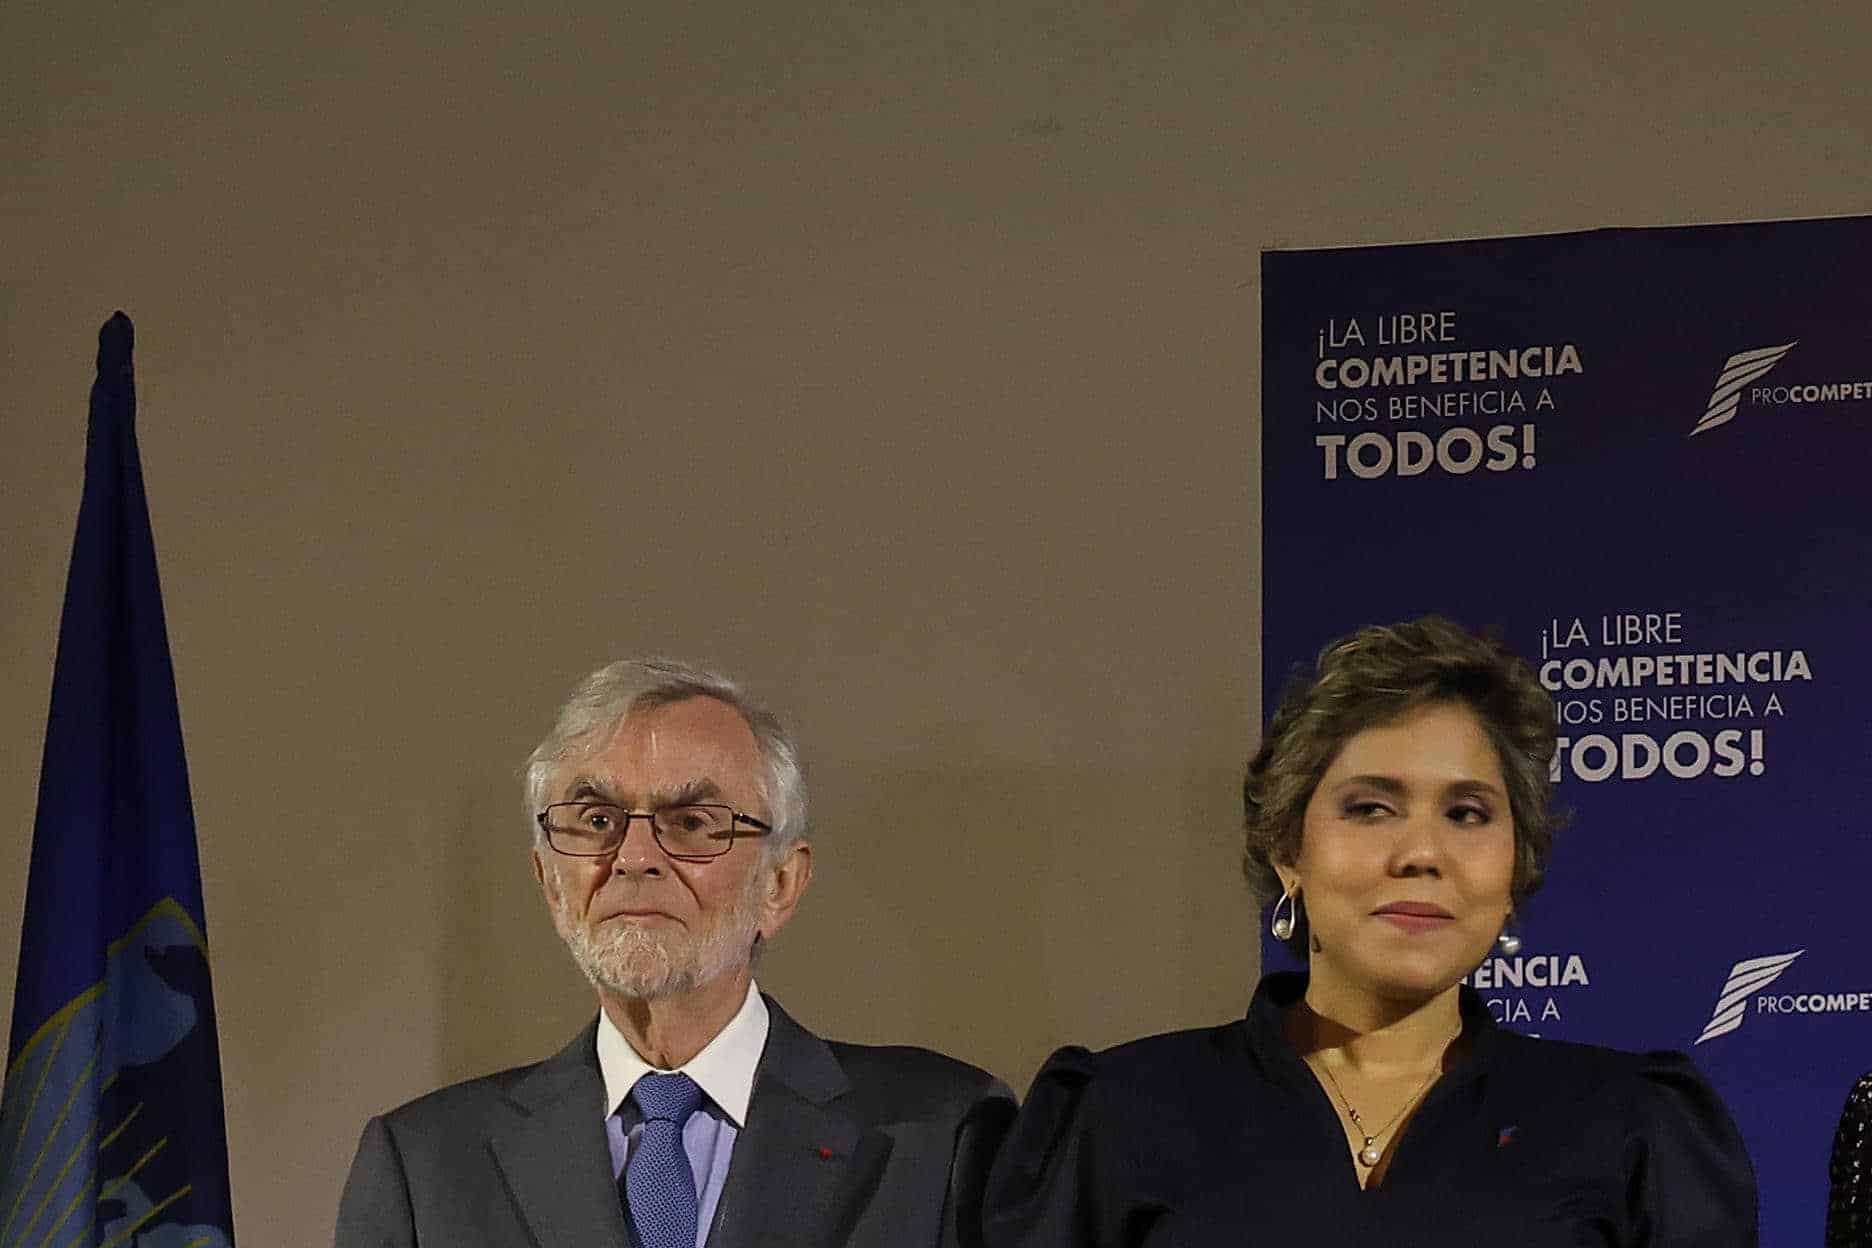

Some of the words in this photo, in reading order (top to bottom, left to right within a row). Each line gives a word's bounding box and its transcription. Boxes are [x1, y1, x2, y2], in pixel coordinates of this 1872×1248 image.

[1320, 319, 1365, 358] ¡LA
[1380, 312, 1455, 344] LIBRE
[1314, 345, 1584, 390] COMPETENCIA
[1317, 398, 1377, 422] NOS
[1390, 391, 1525, 419] BENEFICIA
[1536, 389, 1554, 409] A
[1316, 424, 1535, 479] TODOS!
[1543, 619, 1589, 659] ¡LA
[1604, 614, 1681, 645] LIBRE
[1538, 650, 1813, 691] COMPETENCIA
[1615, 695, 1753, 721] BENEFICIA
[1765, 693, 1783, 715] A
[1542, 999, 1560, 1020] A
